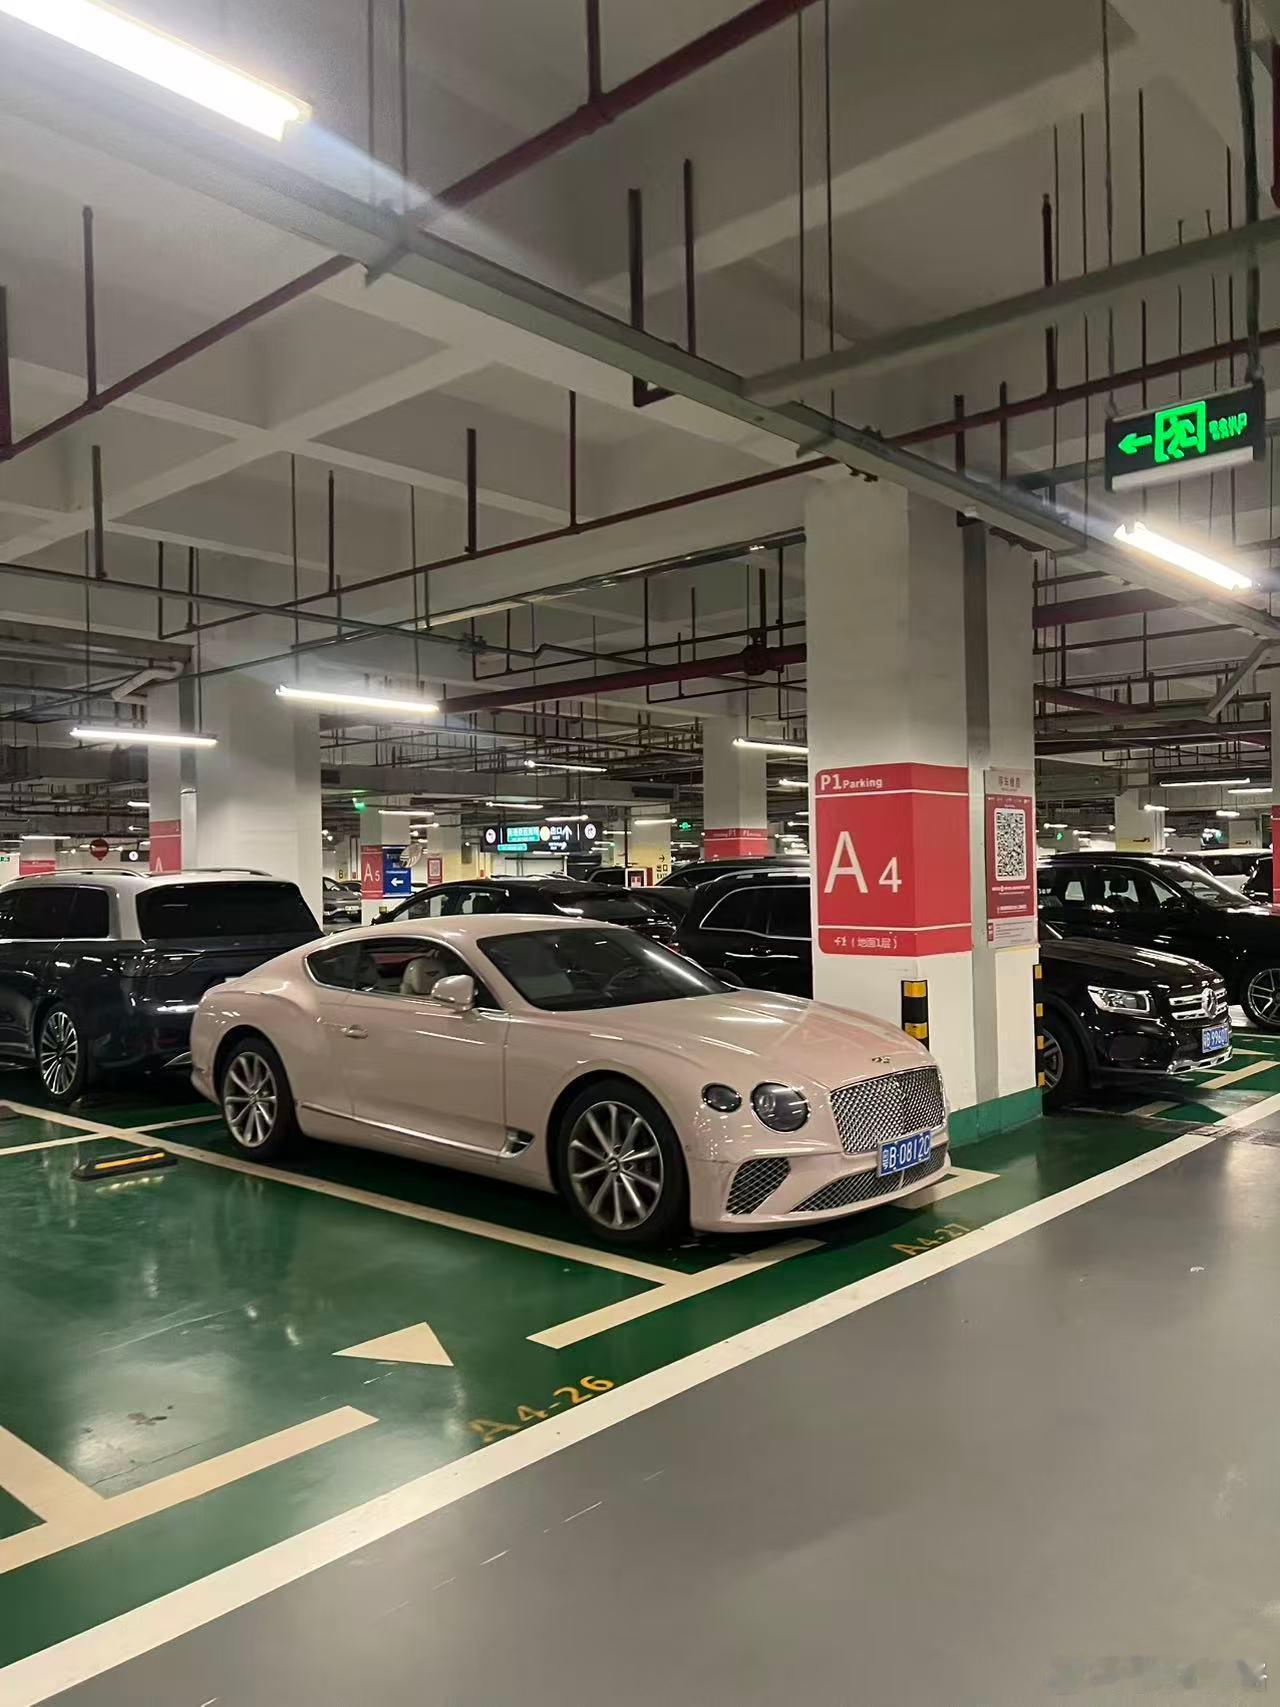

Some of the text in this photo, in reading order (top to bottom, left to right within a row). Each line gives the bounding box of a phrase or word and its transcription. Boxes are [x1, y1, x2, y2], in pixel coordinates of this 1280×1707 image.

[821, 773, 883, 791] P1 Parking
[824, 831, 902, 893] A 4
[890, 1222, 971, 1256] A4-27
[467, 1375, 615, 1443] A4-26
